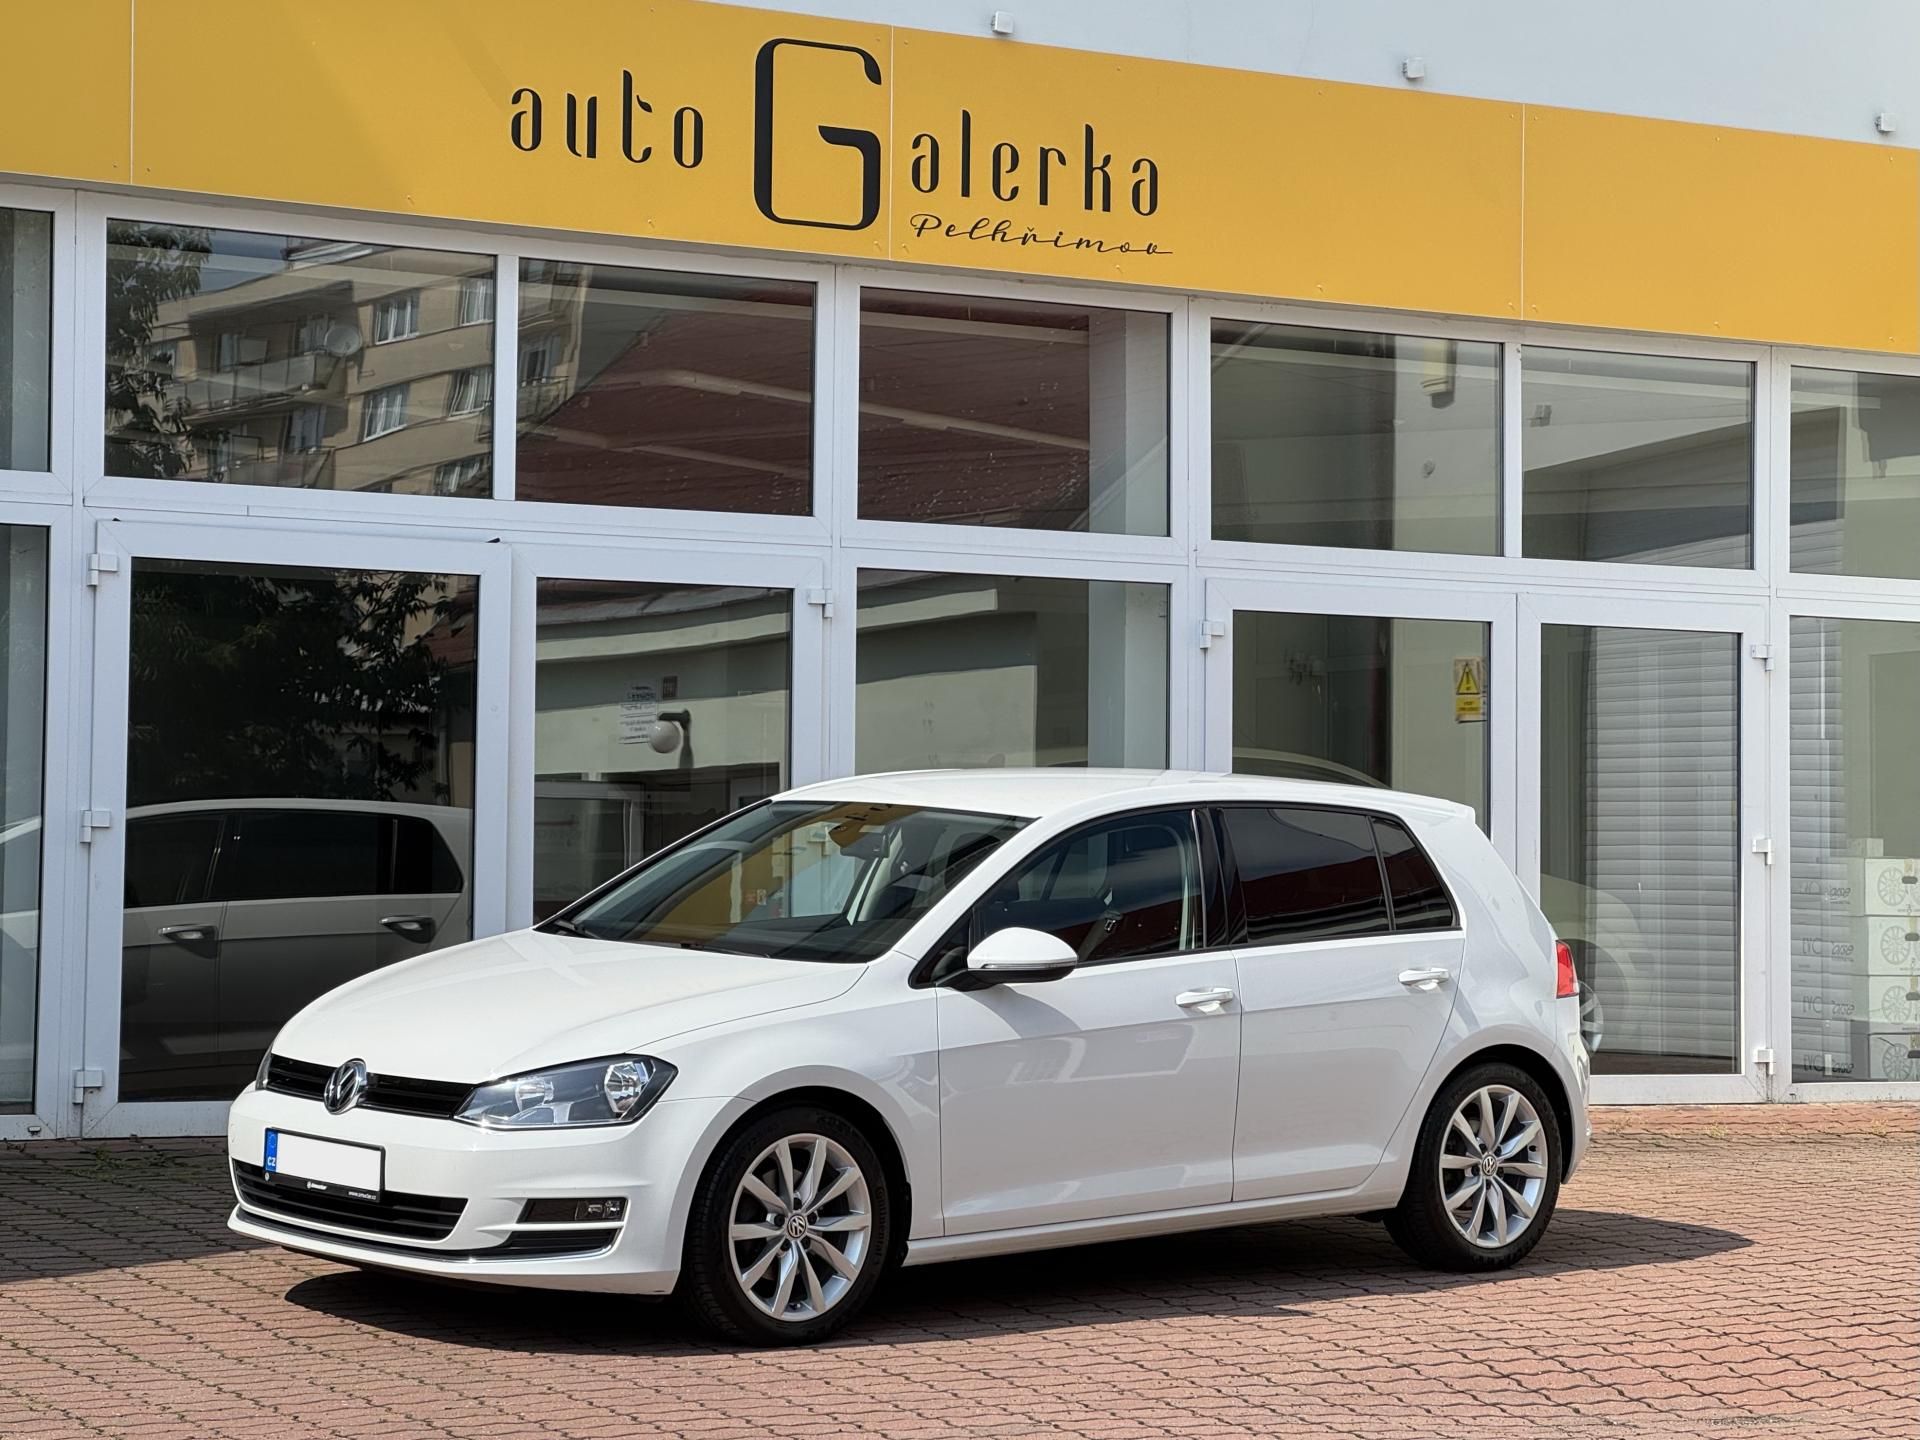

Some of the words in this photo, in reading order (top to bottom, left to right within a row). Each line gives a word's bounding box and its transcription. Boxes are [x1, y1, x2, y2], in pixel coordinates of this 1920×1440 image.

[511, 69, 704, 169] auto
[753, 37, 1159, 232] Galerka
[910, 213, 1173, 255] Pelhřimov
[267, 1157, 276, 1167] CZ
